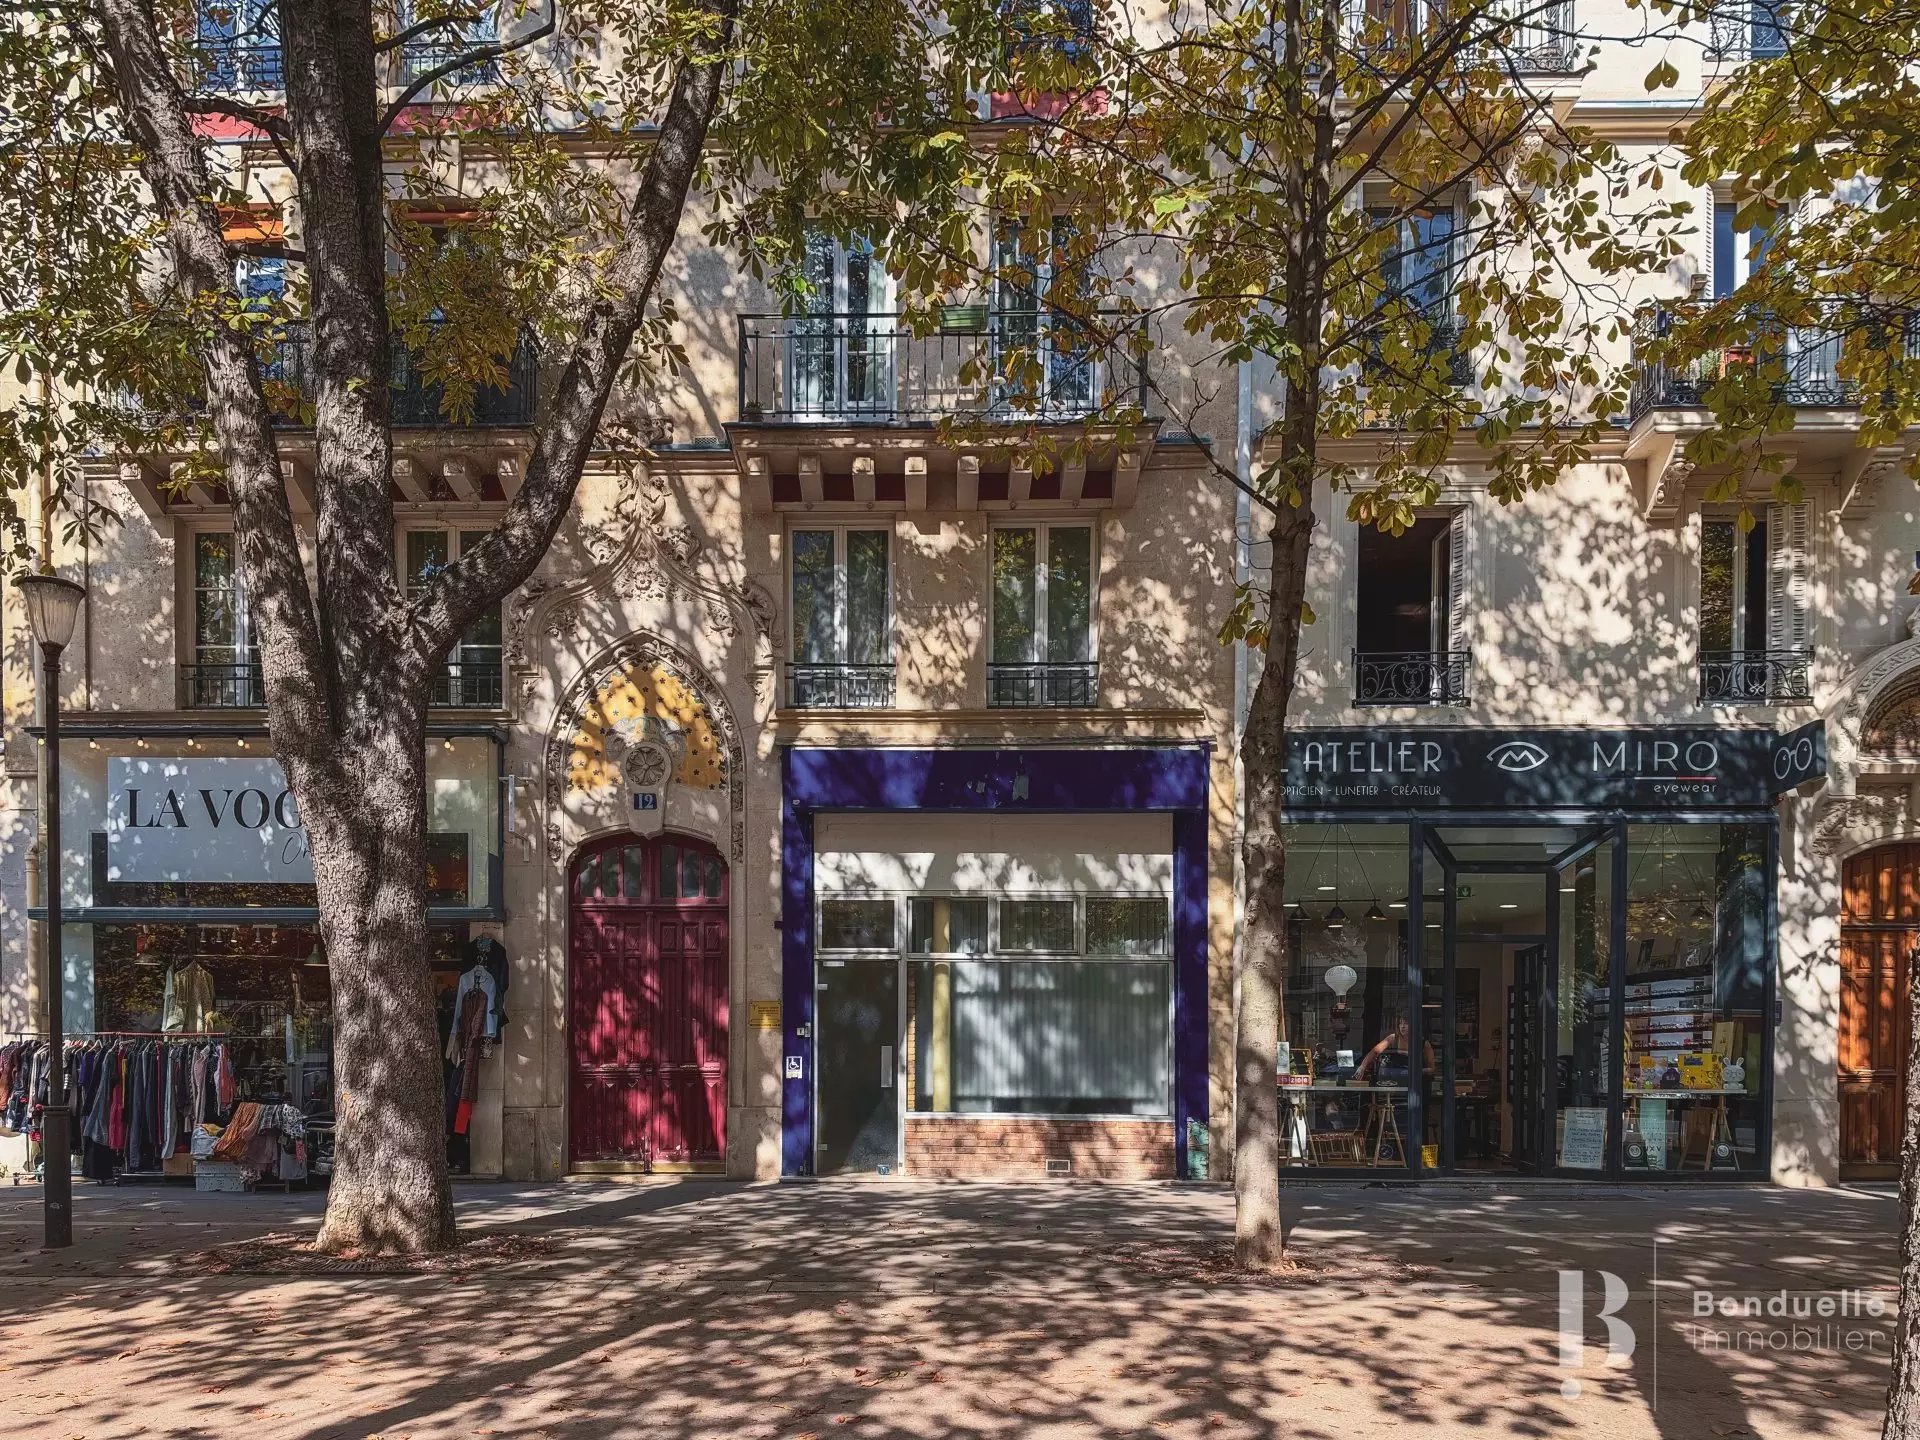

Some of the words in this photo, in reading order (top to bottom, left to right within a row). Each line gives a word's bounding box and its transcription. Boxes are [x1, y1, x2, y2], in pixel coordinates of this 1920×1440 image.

[1280, 741, 1442, 773] 'ATELIER
[1592, 740, 1719, 772] MIRO
[1335, 785, 1379, 796] LUNETIER
[1391, 783, 1442, 796] CRÉATEUR
[1653, 783, 1717, 794] eyewear
[125, 788, 190, 829] LA
[638, 793, 654, 809] 12
